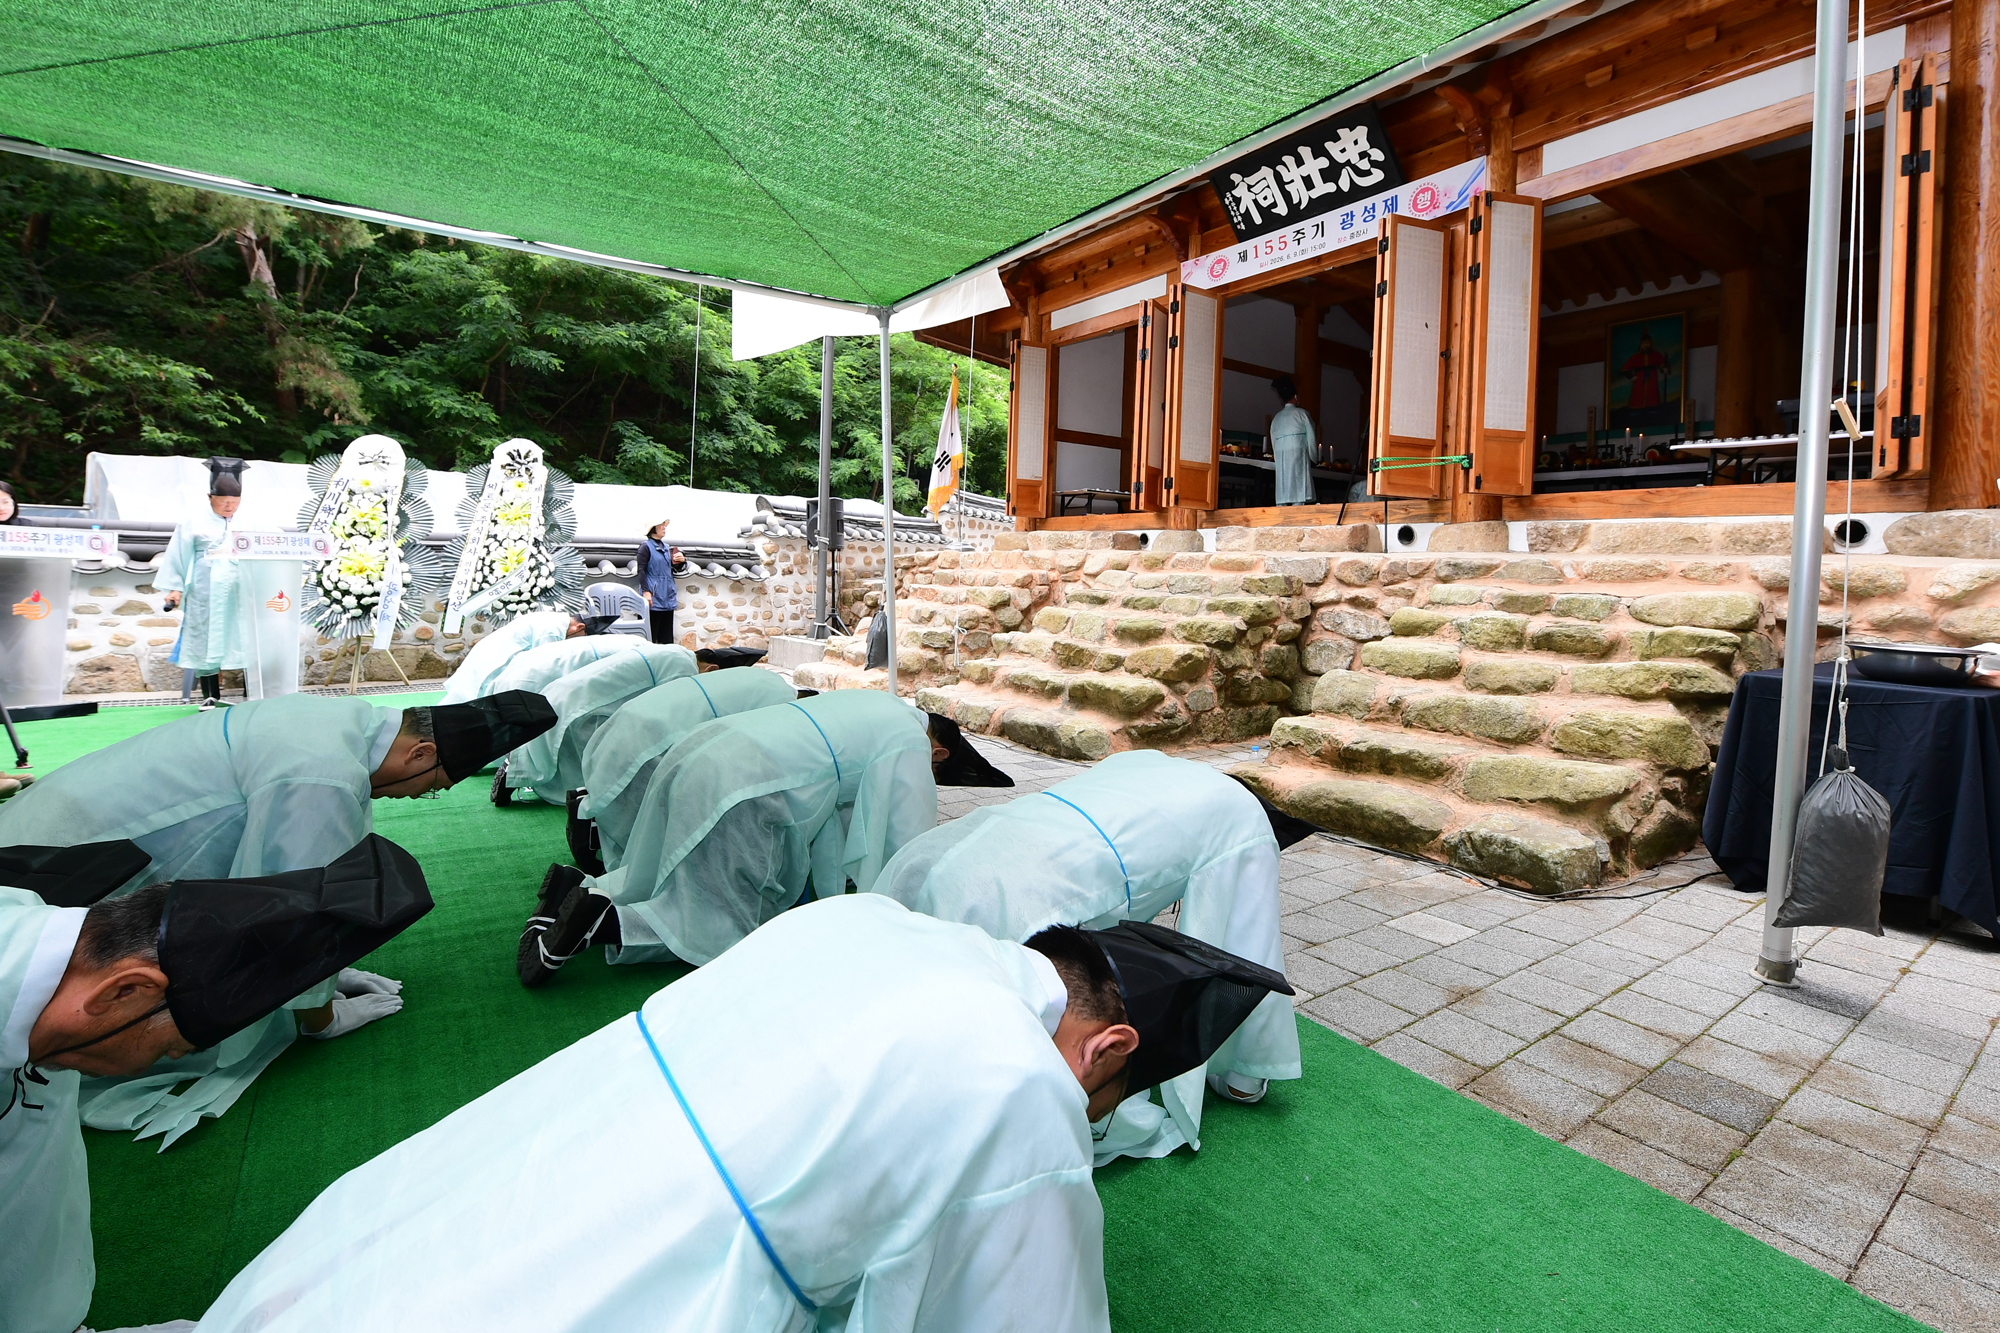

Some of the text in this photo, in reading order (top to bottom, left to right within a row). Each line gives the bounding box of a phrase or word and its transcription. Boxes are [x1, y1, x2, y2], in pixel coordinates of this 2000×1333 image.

[1416, 190, 1432, 209] 행
[1339, 194, 1399, 231] 광성제
[1310, 242, 1327, 252] 15:00
[1212, 261, 1225, 276] 봉
[54, 533, 84, 547] 광성제
[290, 535, 310, 547] 광성제
